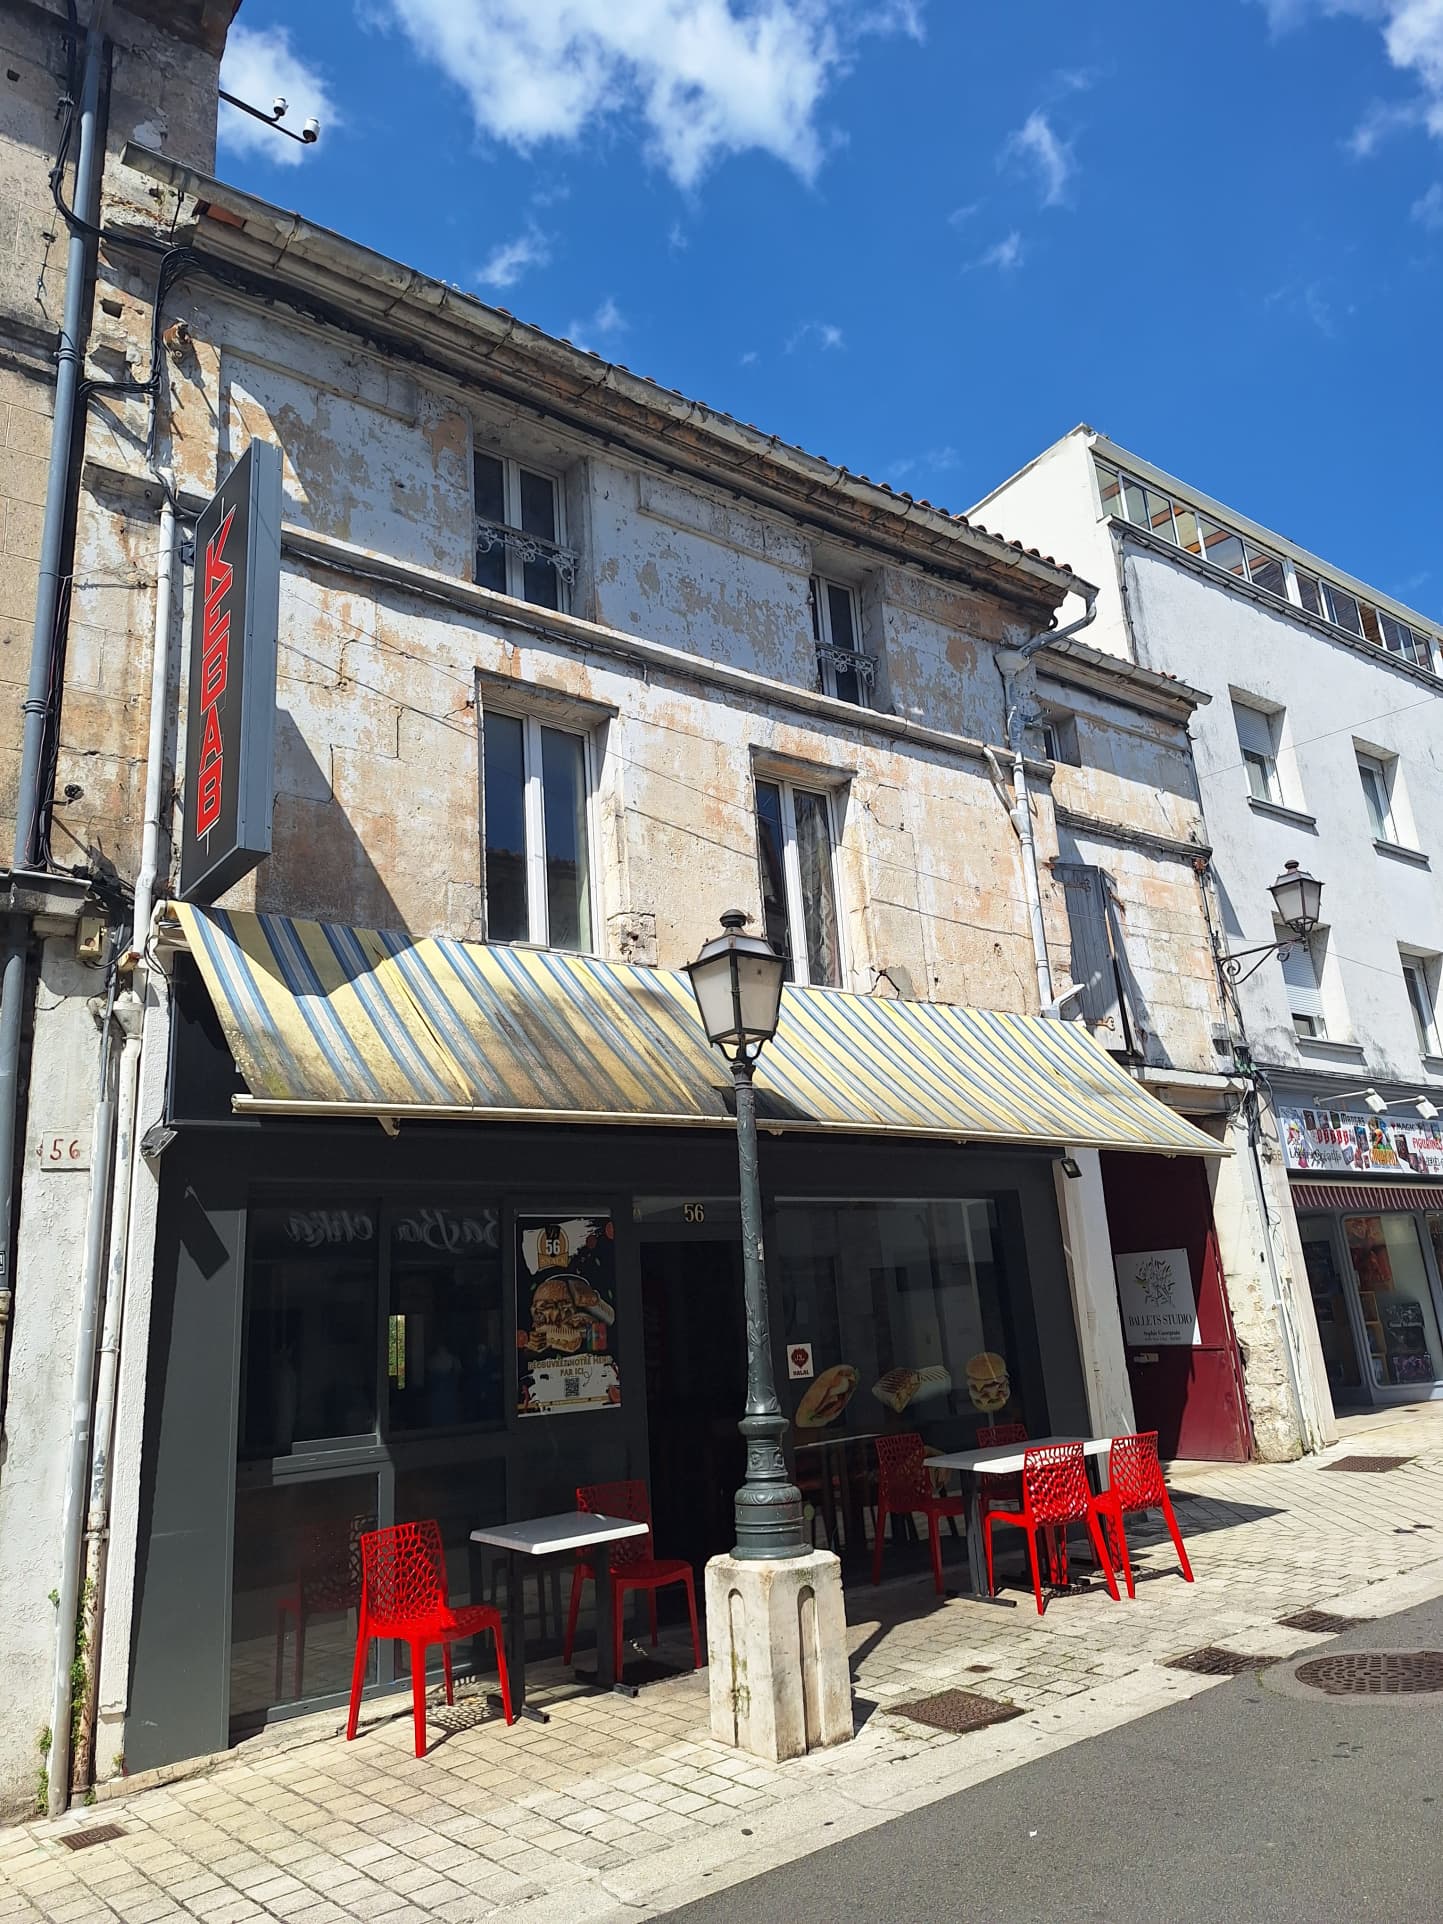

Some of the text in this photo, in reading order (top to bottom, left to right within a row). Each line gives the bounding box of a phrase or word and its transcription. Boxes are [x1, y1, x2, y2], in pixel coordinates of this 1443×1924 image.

[197, 504, 236, 841] KEBAB
[49, 1138, 80, 1160] 56
[684, 1203, 704, 1222] 56
[545, 1238, 561, 1255] 56
[1128, 1313, 1193, 1327] BALLETS STUDIO
